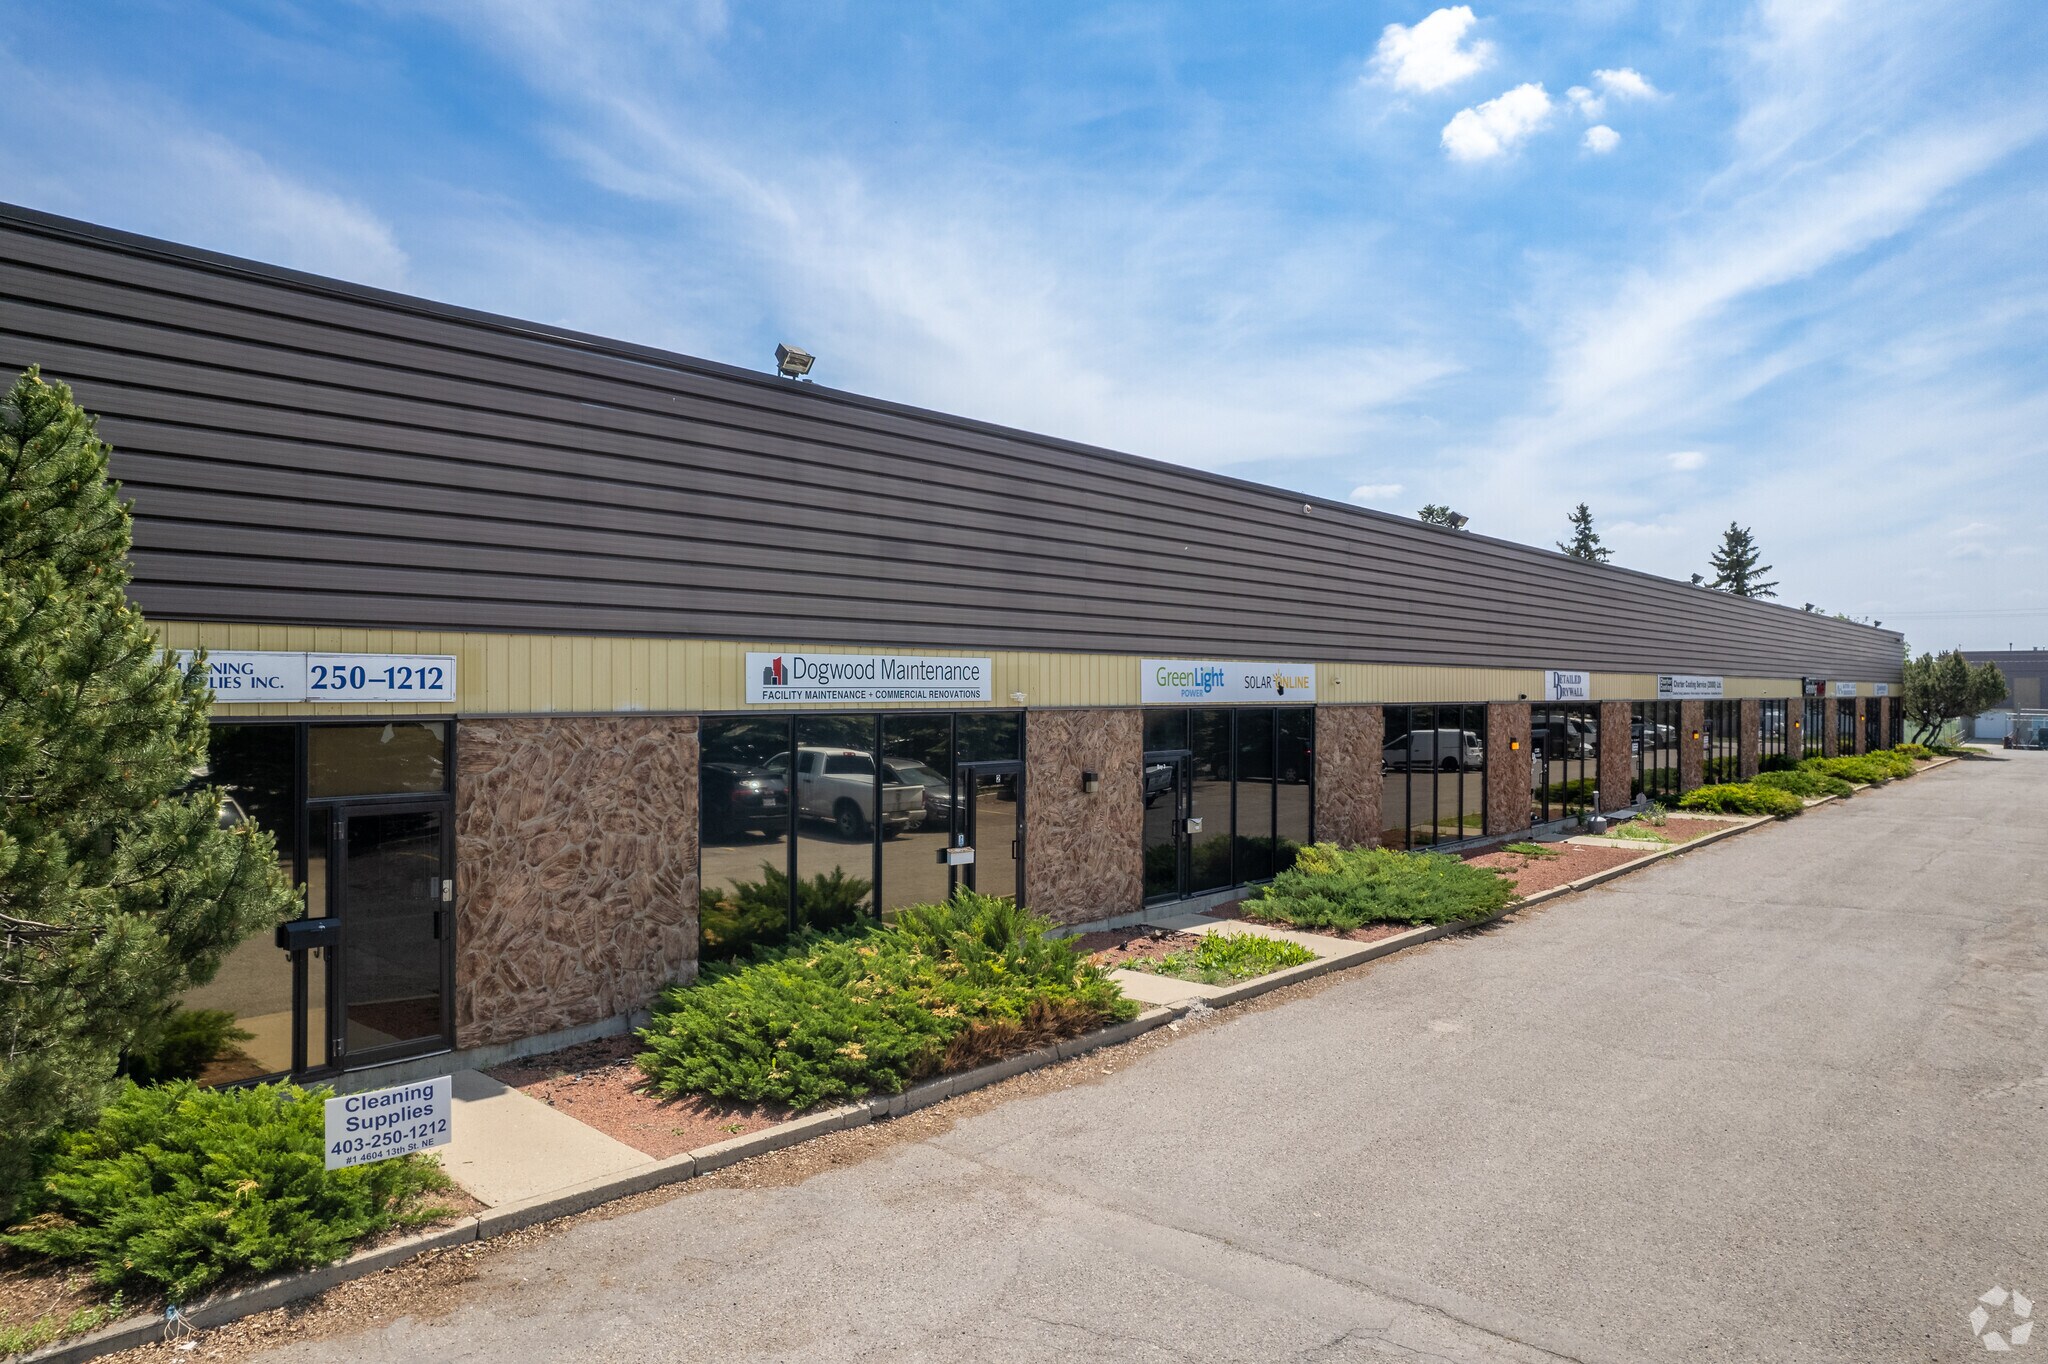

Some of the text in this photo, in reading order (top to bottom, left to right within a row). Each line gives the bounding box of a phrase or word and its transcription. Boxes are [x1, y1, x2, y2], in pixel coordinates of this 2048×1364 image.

[177, 662, 254, 675] NING
[310, 665, 444, 690] 250-1212
[793, 657, 980, 685] Dogwood Maintenance
[250, 676, 284, 689] INC.
[1156, 666, 1225, 693] GreenLight
[1244, 675, 1309, 689] SOLAR ONLINE
[1553, 671, 1582, 688] DETAILED
[762, 690, 802, 700] FACILITY
[805, 690, 866, 699] MAINTENANCE
[875, 689, 927, 699] COMMERCIAL
[928, 689, 981, 699] RENOVATIONS
[1181, 689, 1204, 698] POWER
[1556, 684, 1584, 700] DRYWALL
[345, 1084, 434, 1113] Cleaning
[346, 1104, 434, 1132] Supplies
[331, 1118, 447, 1155] 403-250-1212
[346, 1138, 434, 1164] #1 4604 13th St. NE
